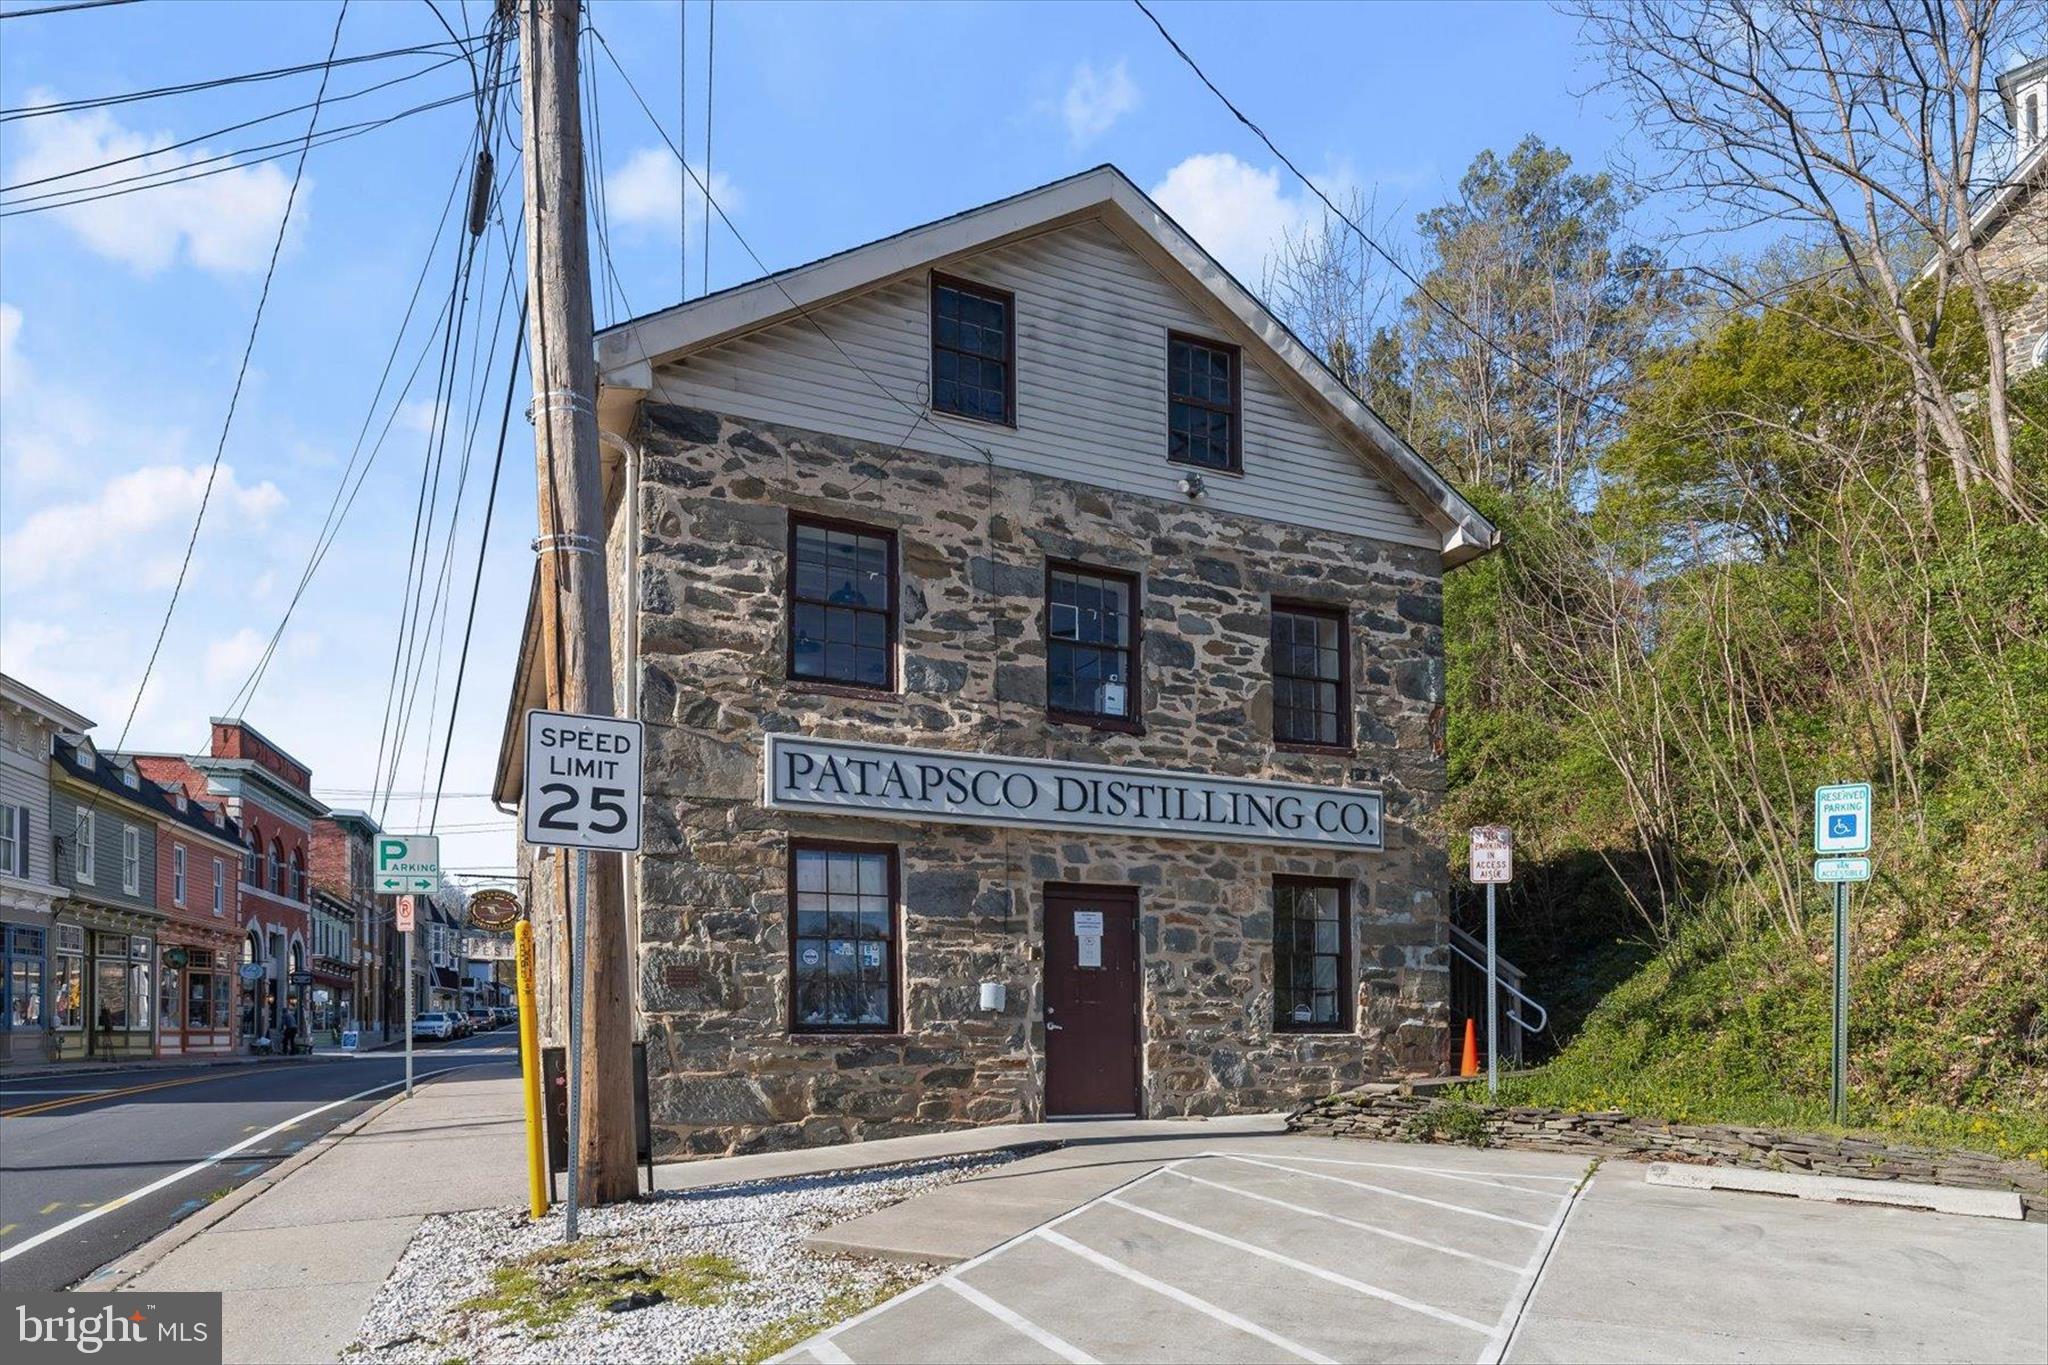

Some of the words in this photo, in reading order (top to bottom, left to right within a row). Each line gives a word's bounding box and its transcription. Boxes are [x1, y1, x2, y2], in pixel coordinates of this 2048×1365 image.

[540, 728, 631, 754] SPEED
[550, 756, 619, 780] LIMIT
[783, 751, 1039, 809] PATAPSCO
[1053, 776, 1306, 830] DISTILLING
[1315, 800, 1374, 836] CO.
[1821, 790, 1866, 801] RESERVED
[538, 783, 628, 834] 25
[1824, 802, 1862, 812] PARKING
[1476, 861, 1507, 869] ACCESS
